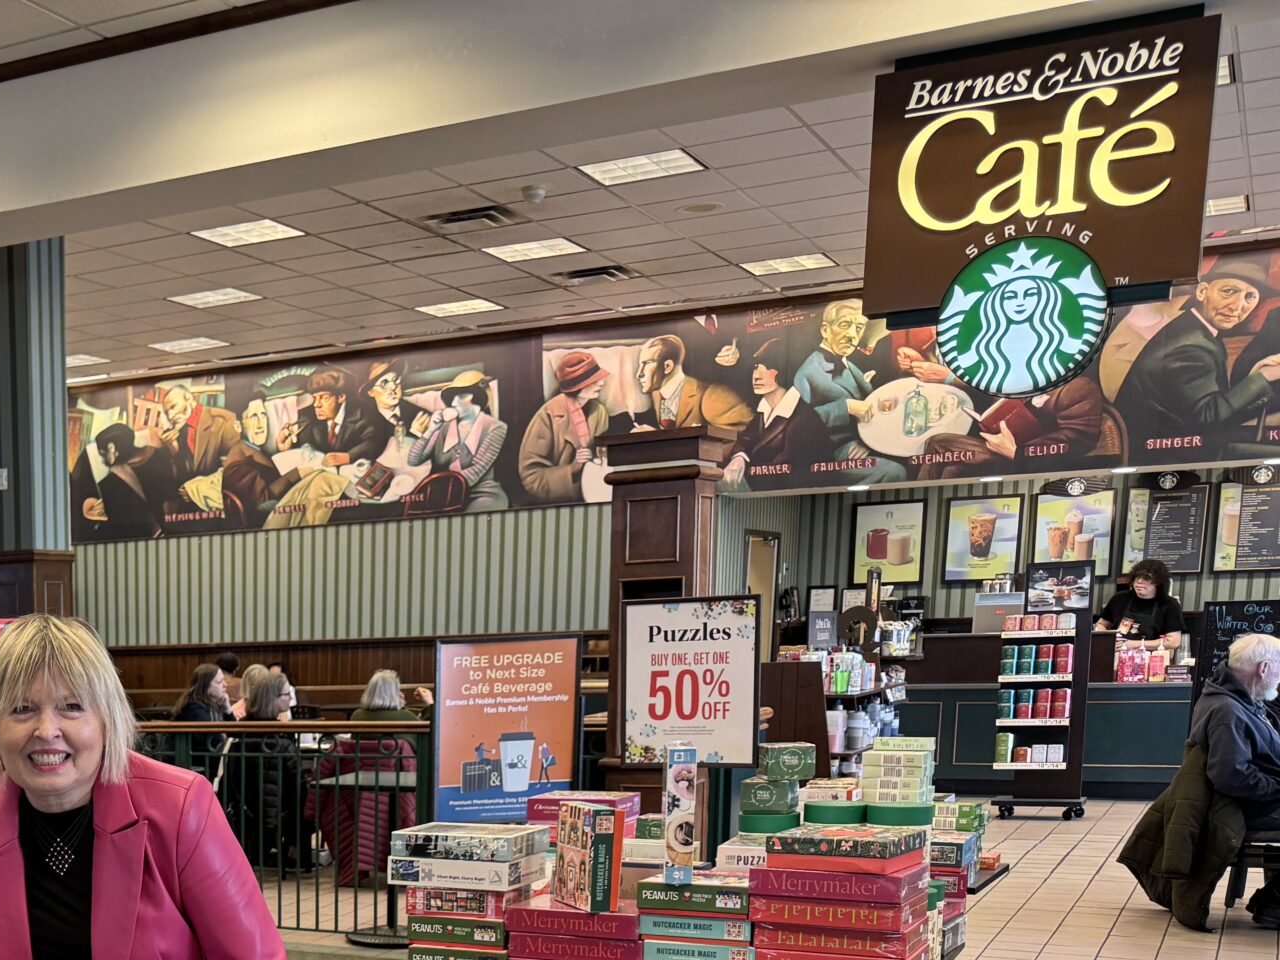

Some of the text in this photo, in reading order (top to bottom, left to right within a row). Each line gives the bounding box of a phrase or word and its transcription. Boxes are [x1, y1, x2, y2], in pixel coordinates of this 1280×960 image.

[905, 35, 1184, 110] Barnes & Noble
[898, 82, 1179, 231] Café
[965, 219, 1094, 259] SERVING
[1028, 443, 1067, 456] ELIOT
[1146, 435, 1202, 449] SINGER
[910, 450, 975, 465] STEINBECK
[749, 463, 791, 475] PARKER
[811, 459, 875, 472] FAULKNER
[647, 622, 732, 643] Puzzles
[453, 652, 564, 668] FREE UPGRADE
[650, 651, 730, 668] BUY ONE, GET ONE
[469, 666, 545, 680] to Next Size
[461, 682, 552, 695] Café Beverage
[647, 668, 730, 721] 50%
[496, 696, 526, 704] Premium
[527, 694, 569, 703] Membership
[701, 701, 730, 719] OFF
[768, 872, 880, 896] Merrymaker
[642, 890, 678, 900] PEANUTS
[652, 920, 712, 931] NUTCRACKER MAGIC
